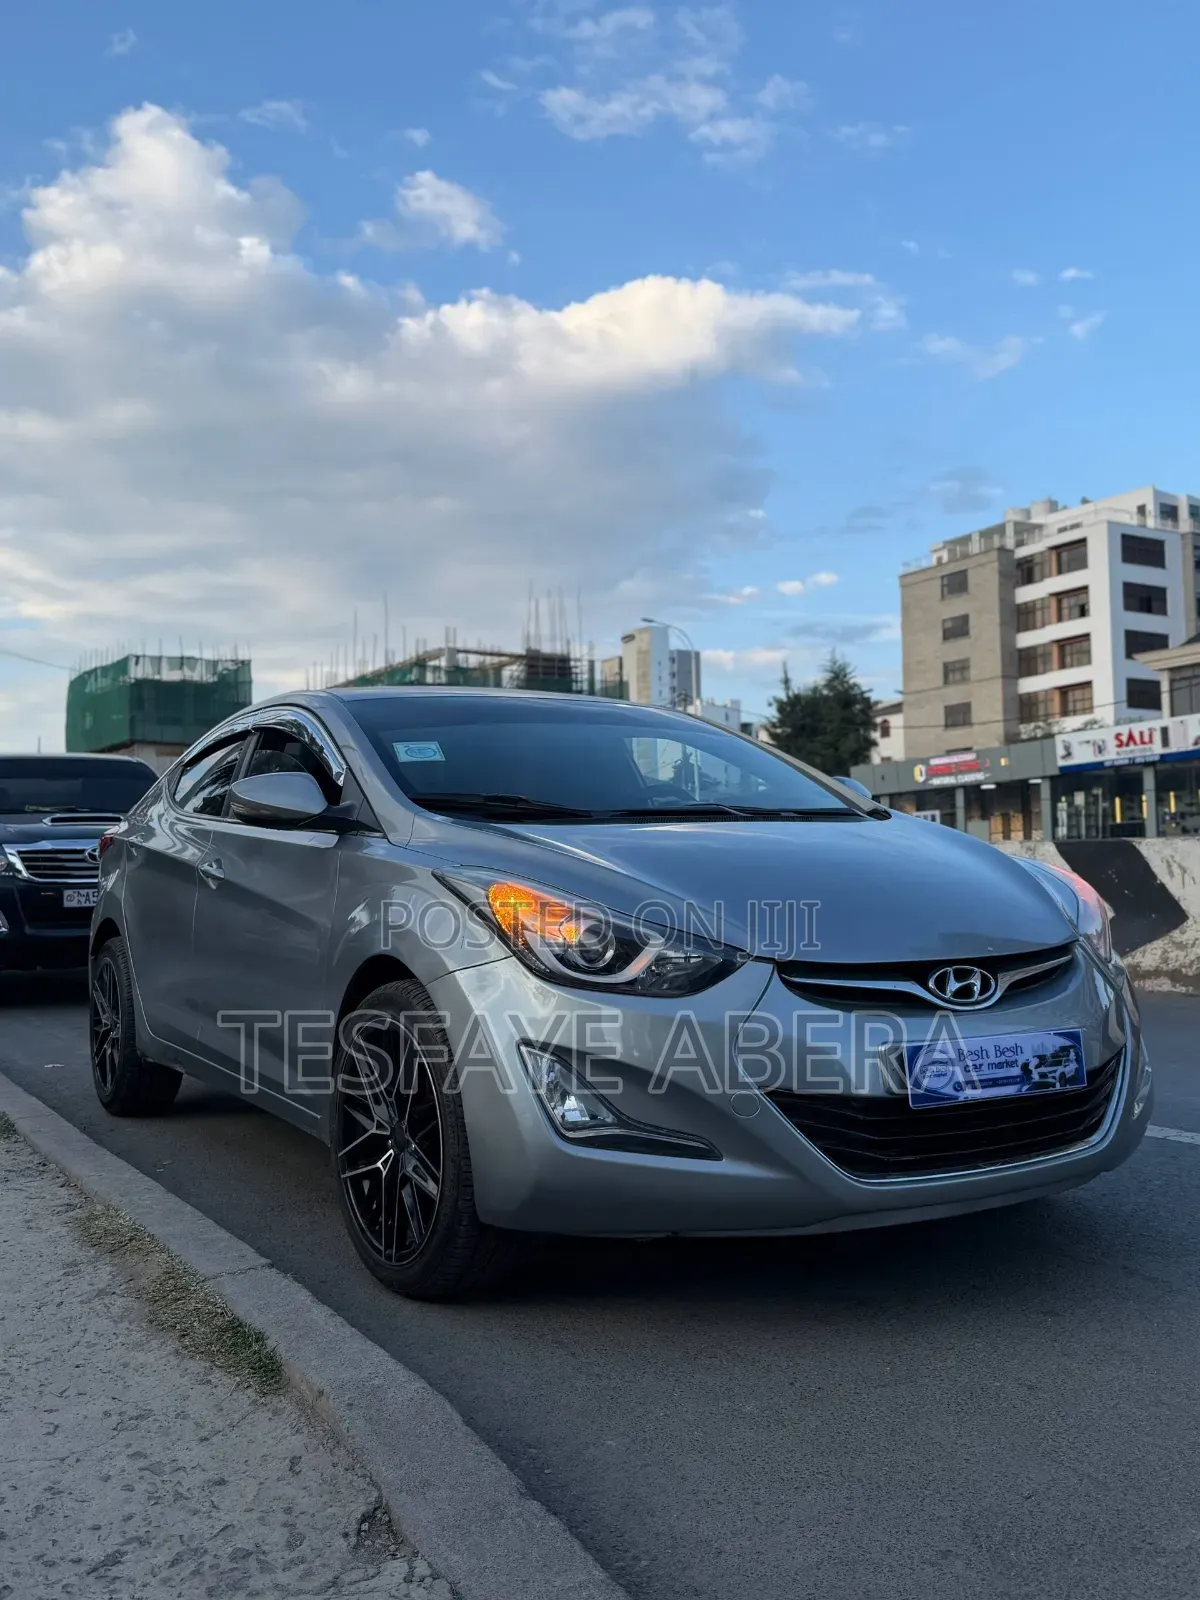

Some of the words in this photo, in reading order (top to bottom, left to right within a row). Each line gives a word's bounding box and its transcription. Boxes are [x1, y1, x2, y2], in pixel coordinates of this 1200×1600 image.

[957, 1046, 989, 1062] Besh
[994, 1043, 1024, 1059] Besh
[963, 1063, 984, 1073] car
[987, 1058, 1020, 1071] market
